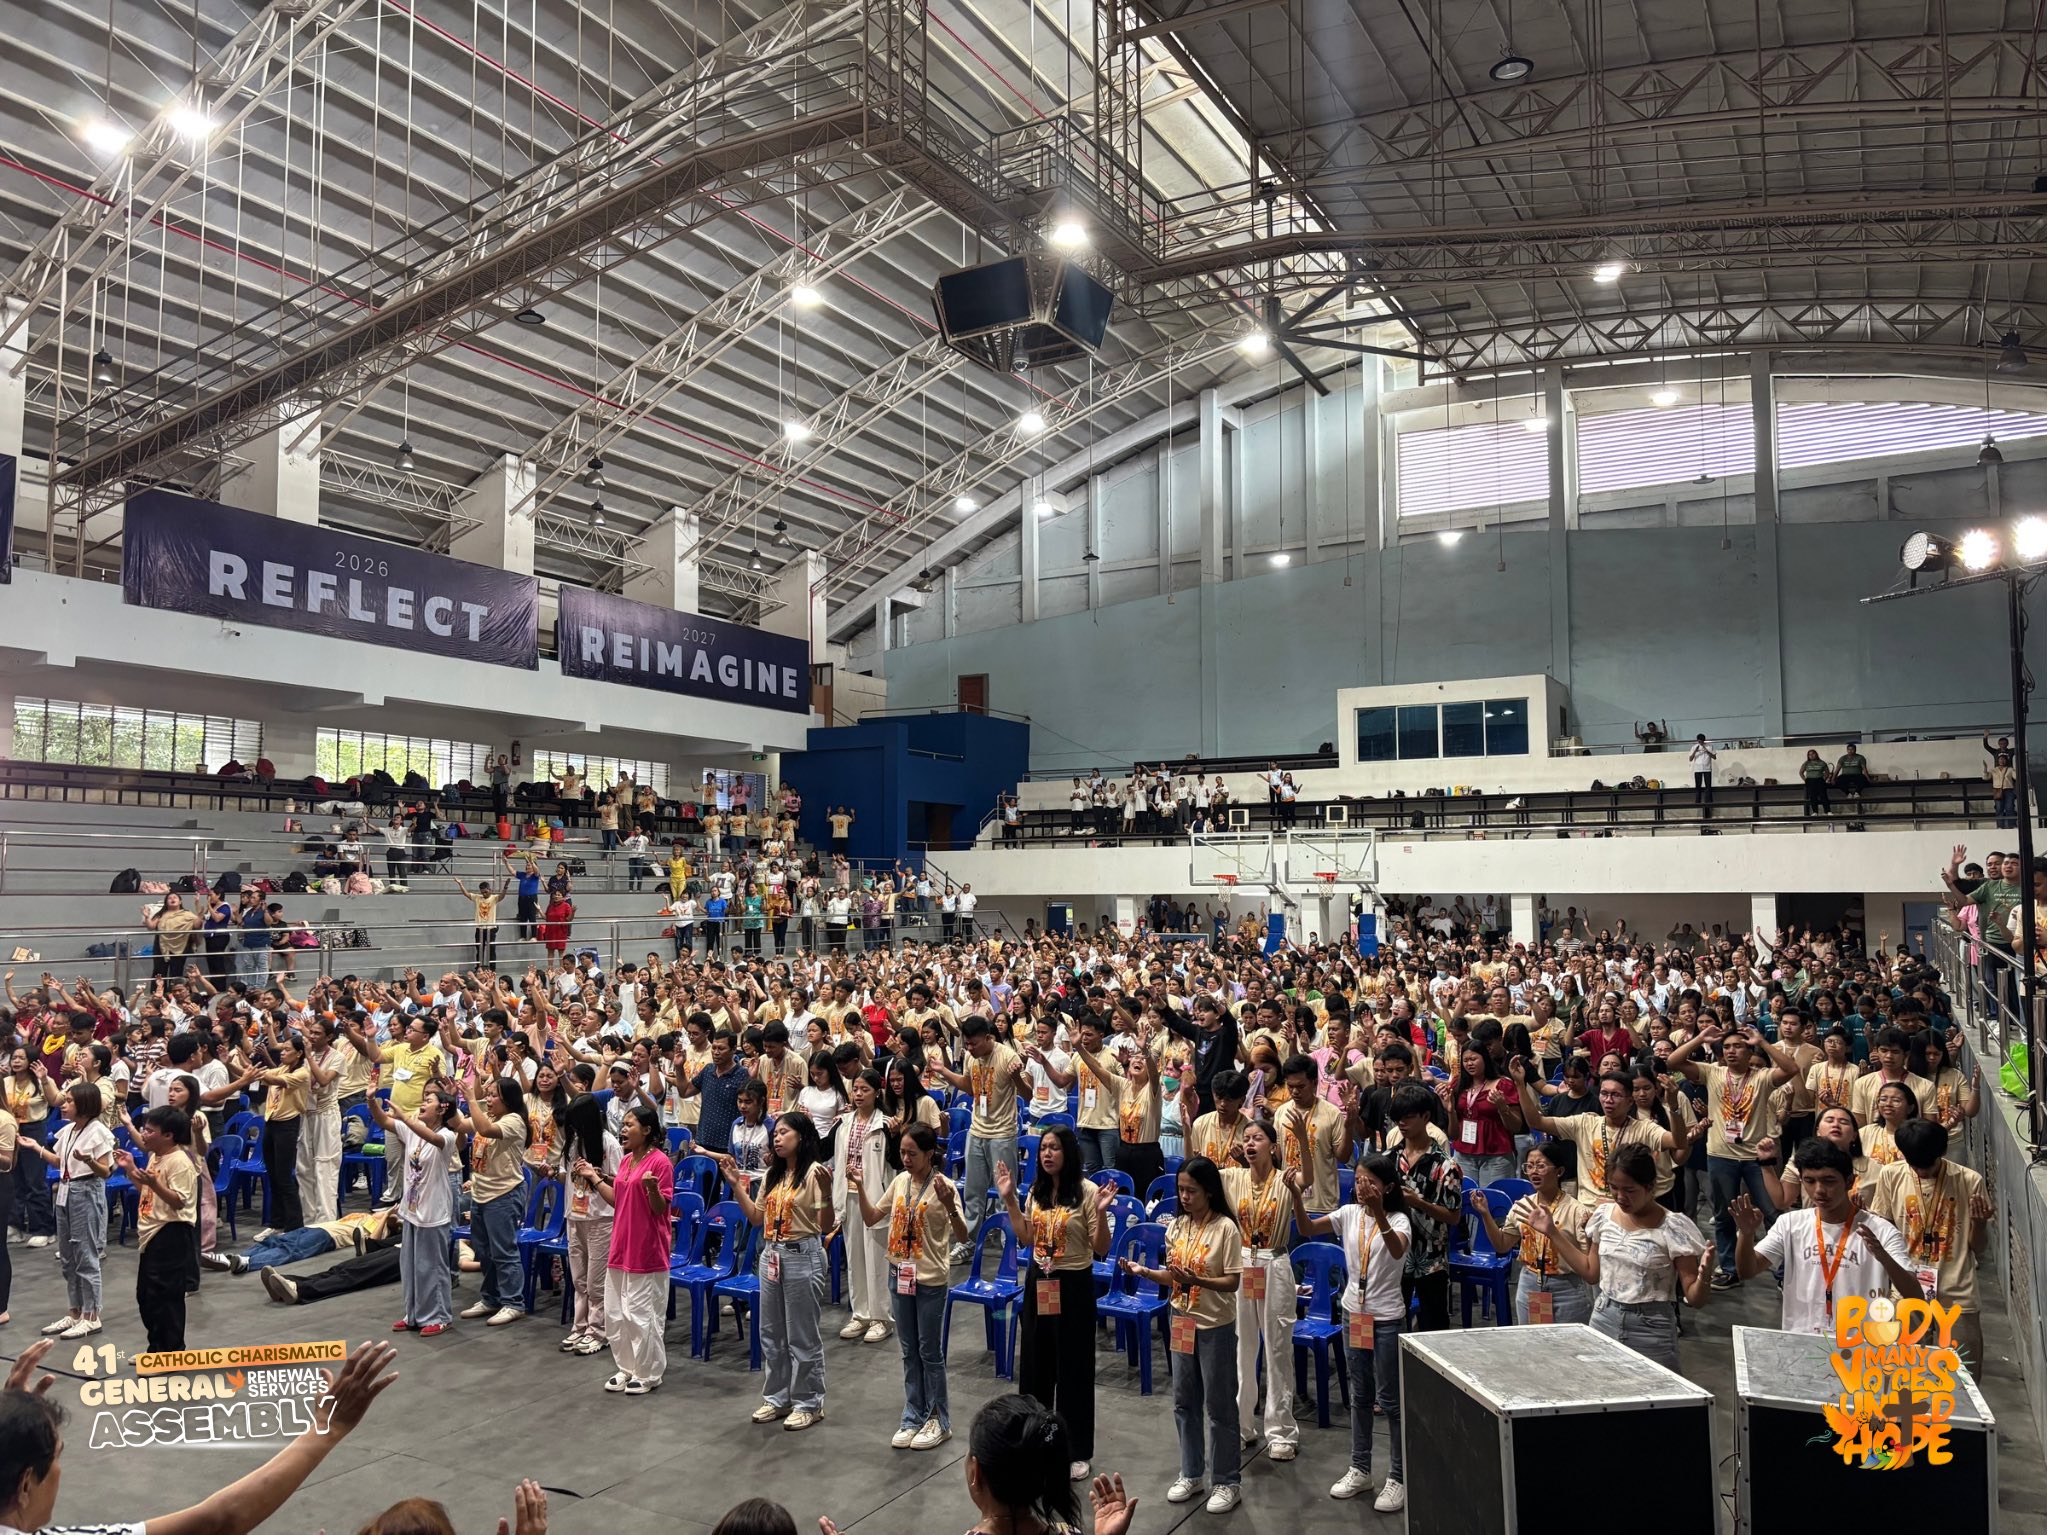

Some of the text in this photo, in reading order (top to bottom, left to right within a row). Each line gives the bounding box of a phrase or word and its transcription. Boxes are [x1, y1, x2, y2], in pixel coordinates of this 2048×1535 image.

[335, 551, 390, 577] 2026
[208, 549, 489, 643] REFLECT
[682, 627, 717, 646] 2027
[580, 625, 799, 699] REIMAGINE
